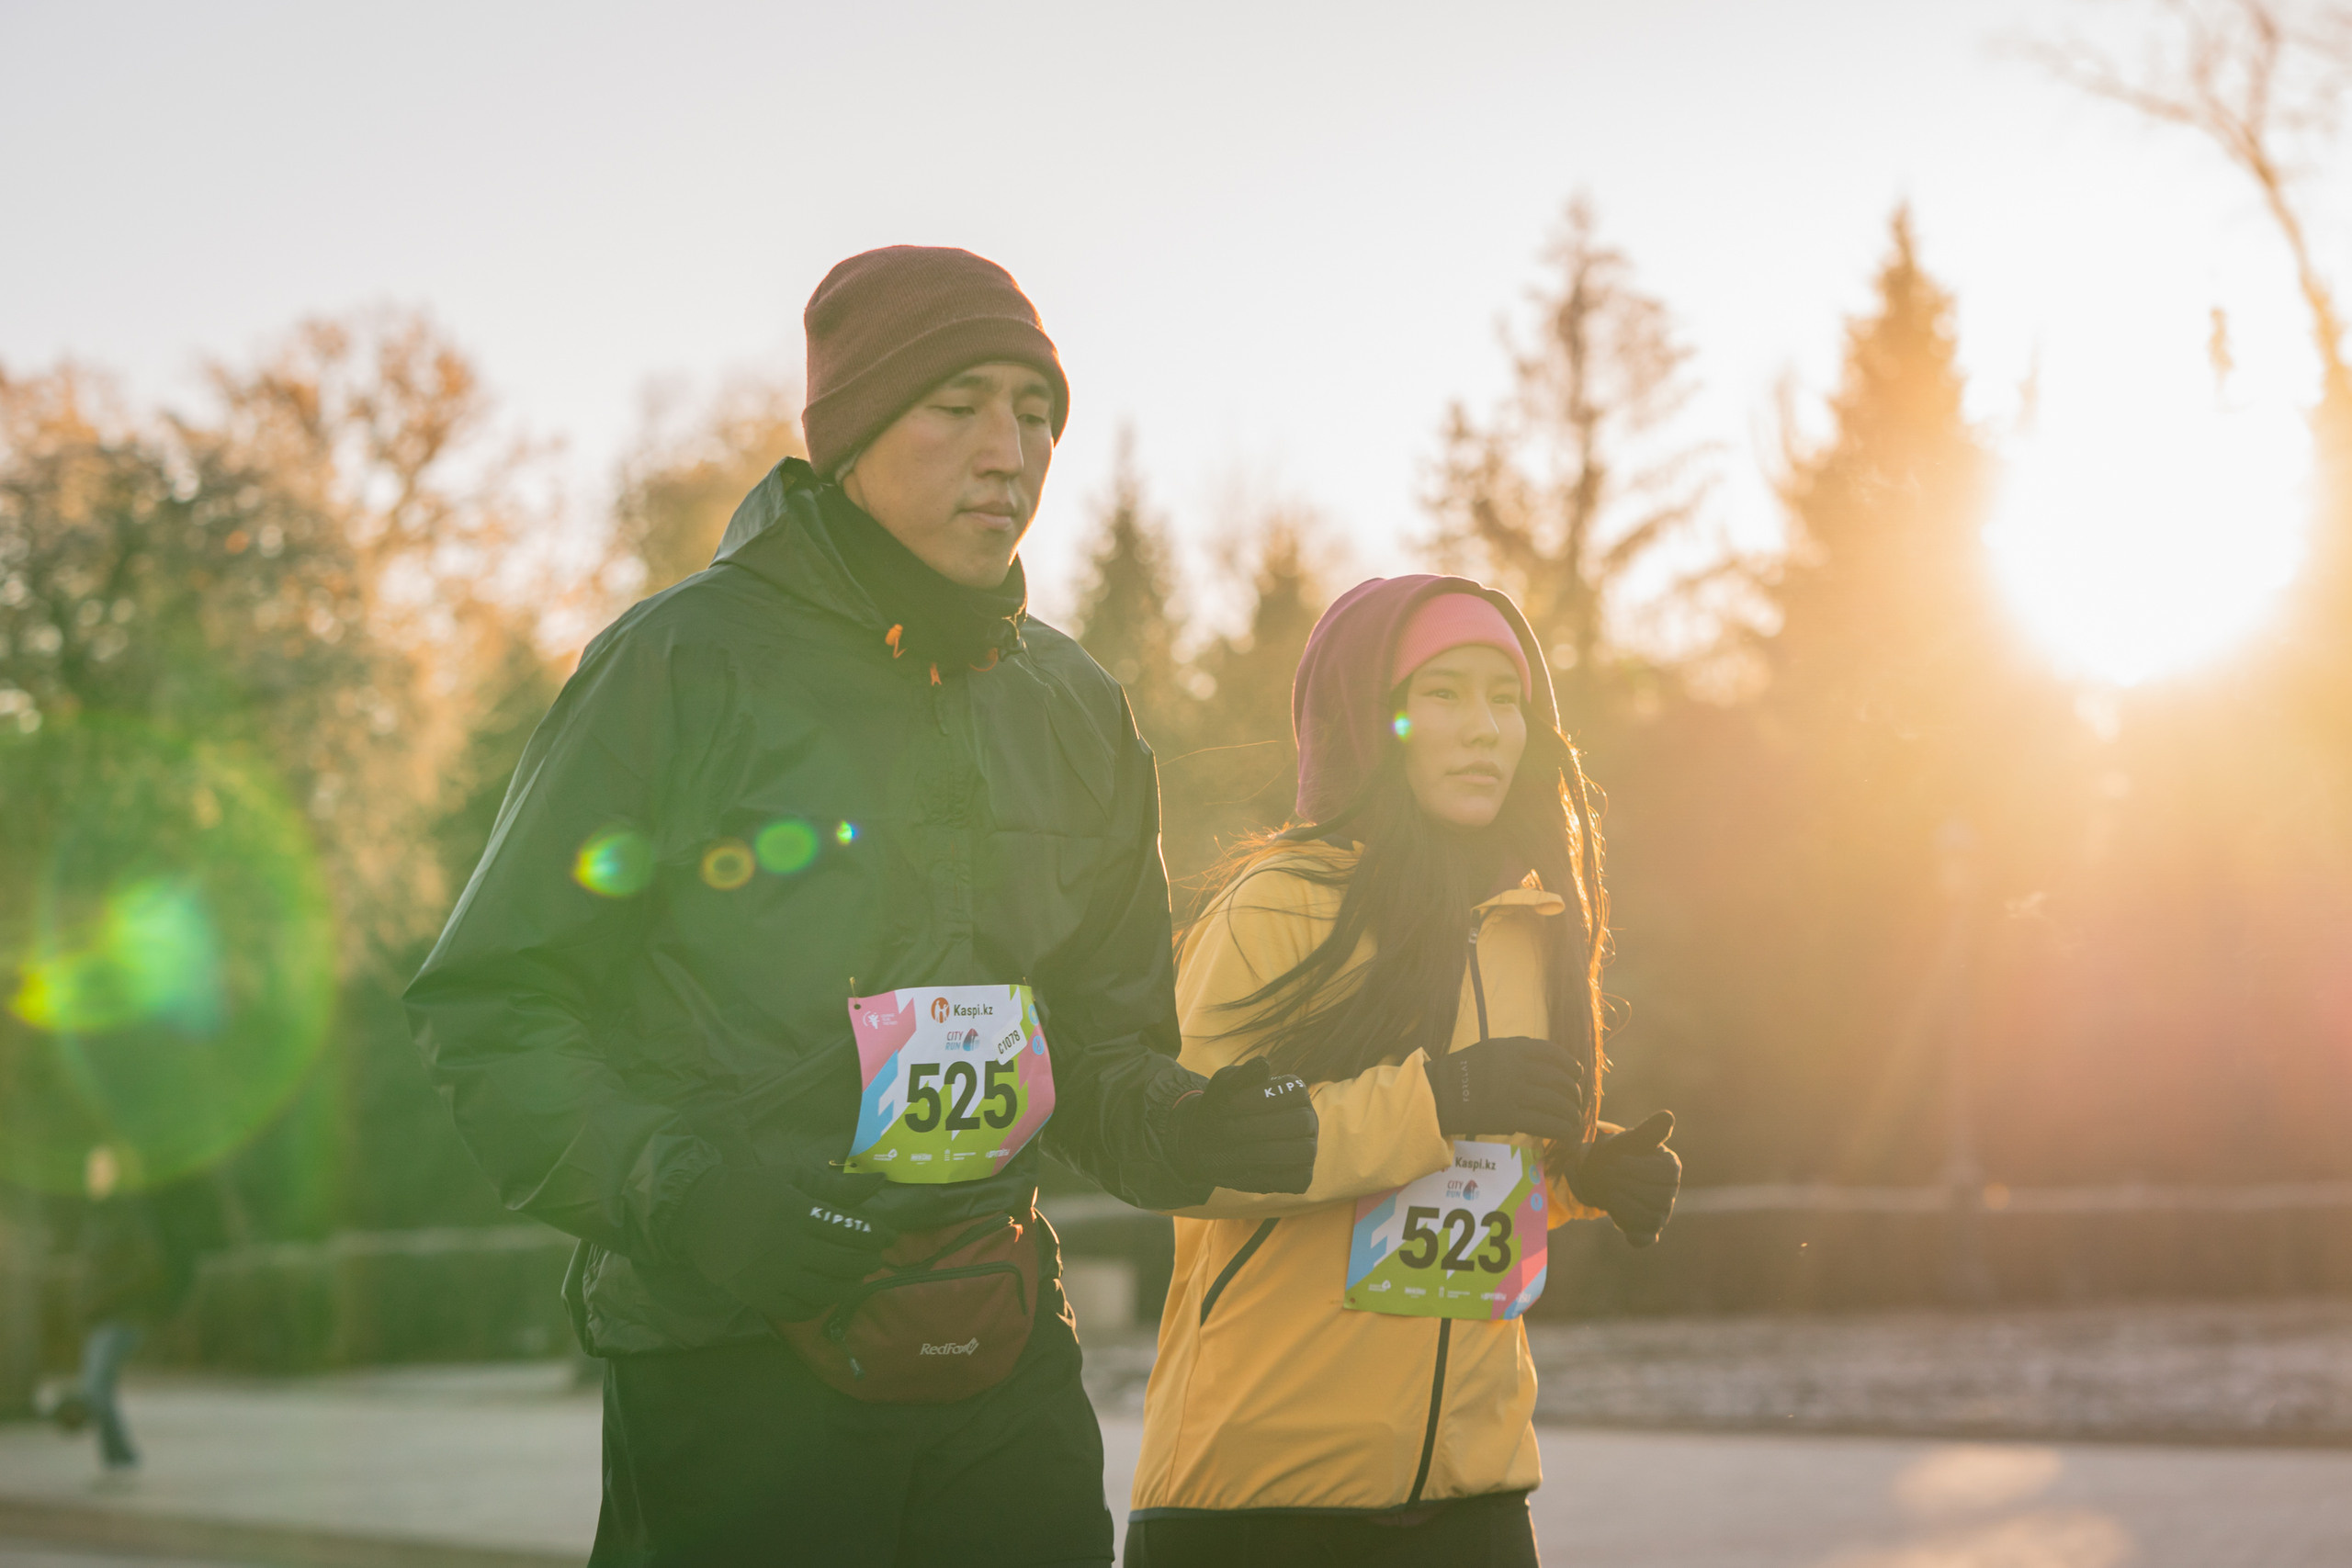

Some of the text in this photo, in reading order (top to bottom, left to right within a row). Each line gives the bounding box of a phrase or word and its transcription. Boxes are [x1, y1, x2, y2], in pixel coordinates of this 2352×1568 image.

[954, 1004, 993, 1019] Kaspi.kz
[946, 1031, 964, 1041] CITY
[998, 1030, 1021, 1055] C1078
[944, 1042, 961, 1050] RUN
[904, 1060, 1018, 1133] 525
[1455, 1156, 1497, 1172] Kaspi.kz
[1447, 1179, 1464, 1190] CITY
[809, 1206, 872, 1233] KIPSTA
[1398, 1205, 1512, 1273] 523
